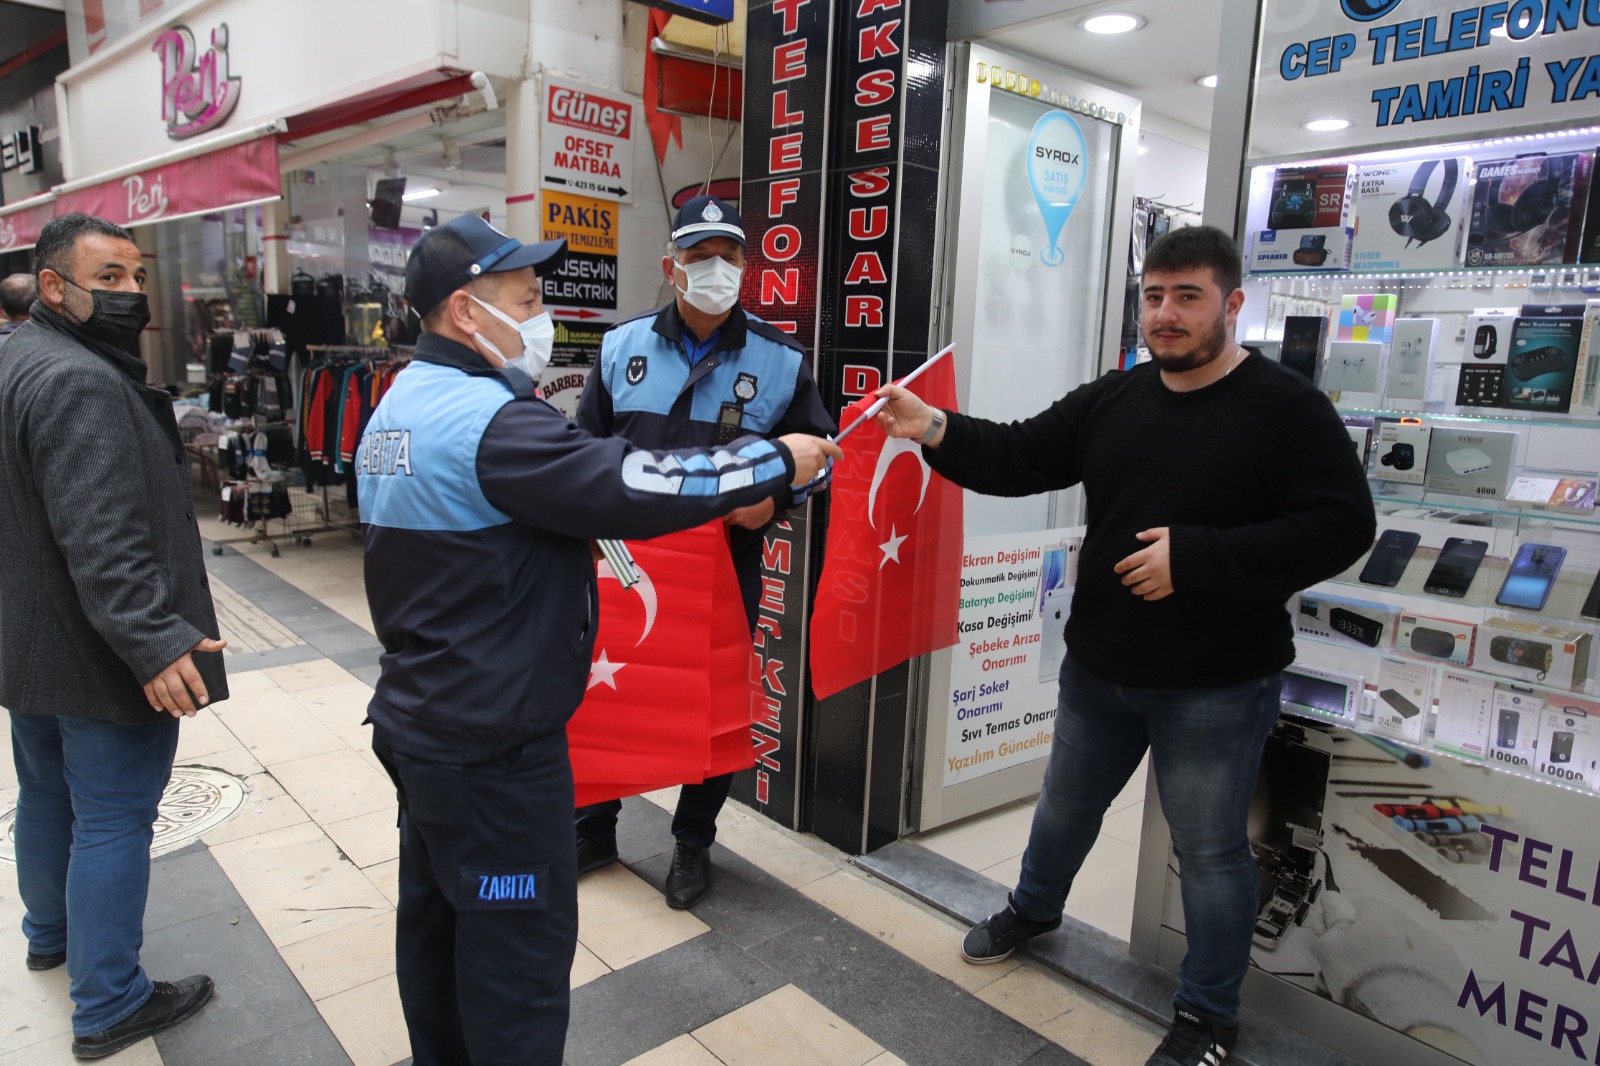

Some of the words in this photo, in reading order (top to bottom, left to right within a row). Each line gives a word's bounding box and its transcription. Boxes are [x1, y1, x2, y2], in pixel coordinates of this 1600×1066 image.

[1280, 33, 1356, 81] CEP
[152, 22, 241, 141] Peri
[1371, 57, 1530, 127] TAMİRİ
[551, 88, 629, 136] Güneş
[564, 135, 614, 159] OFSET
[1036, 146, 1079, 165] SYROX
[553, 151, 622, 178] MATBAA
[1480, 165, 1518, 178] GAMES
[1044, 170, 1069, 186] SATIŞ
[1361, 180, 1385, 188] EXTRA
[123, 174, 168, 222] Peri
[1319, 193, 1341, 206] SR
[1361, 186, 1380, 194] BASS
[548, 202, 611, 236] PAKİŞ
[570, 232, 615, 250] TEMİZLEME
[1010, 248, 1032, 257] SYROX
[1355, 252, 1381, 260] STEREO
[1354, 261, 1400, 269] HEADPHONES
[544, 280, 615, 301] ELEKTRİK
[543, 374, 585, 400] BARBER
[1457, 435, 1484, 444] SYROX
[357, 429, 412, 477] ABITA
[1475, 486, 1497, 496] 4000
[963, 554, 994, 568] Ekran
[997, 547, 1040, 565] Değişimi
[960, 572, 1006, 587] Dokunmatik
[1008, 568, 1039, 582] Değişimi
[960, 595, 995, 609] Batarya
[997, 588, 1035, 604] Değişimi
[957, 621, 984, 634] Kasa
[987, 609, 1032, 628] Değişimi
[969, 637, 1010, 658] Şebeke
[1013, 633, 1040, 647] Arıza
[982, 654, 1027, 672] Onarımı
[952, 686, 976, 707] Şarj
[979, 680, 1010, 697] Soket
[957, 701, 1003, 721] Onarımı
[961, 729, 982, 743] Sıvı
[985, 718, 1020, 736] Temas
[947, 749, 994, 772] Yazılım
[1489, 748, 1528, 767] 10000
[1540, 762, 1584, 781] 10000
[478, 874, 536, 900] ZABITA
[1457, 968, 1600, 1066] MER
